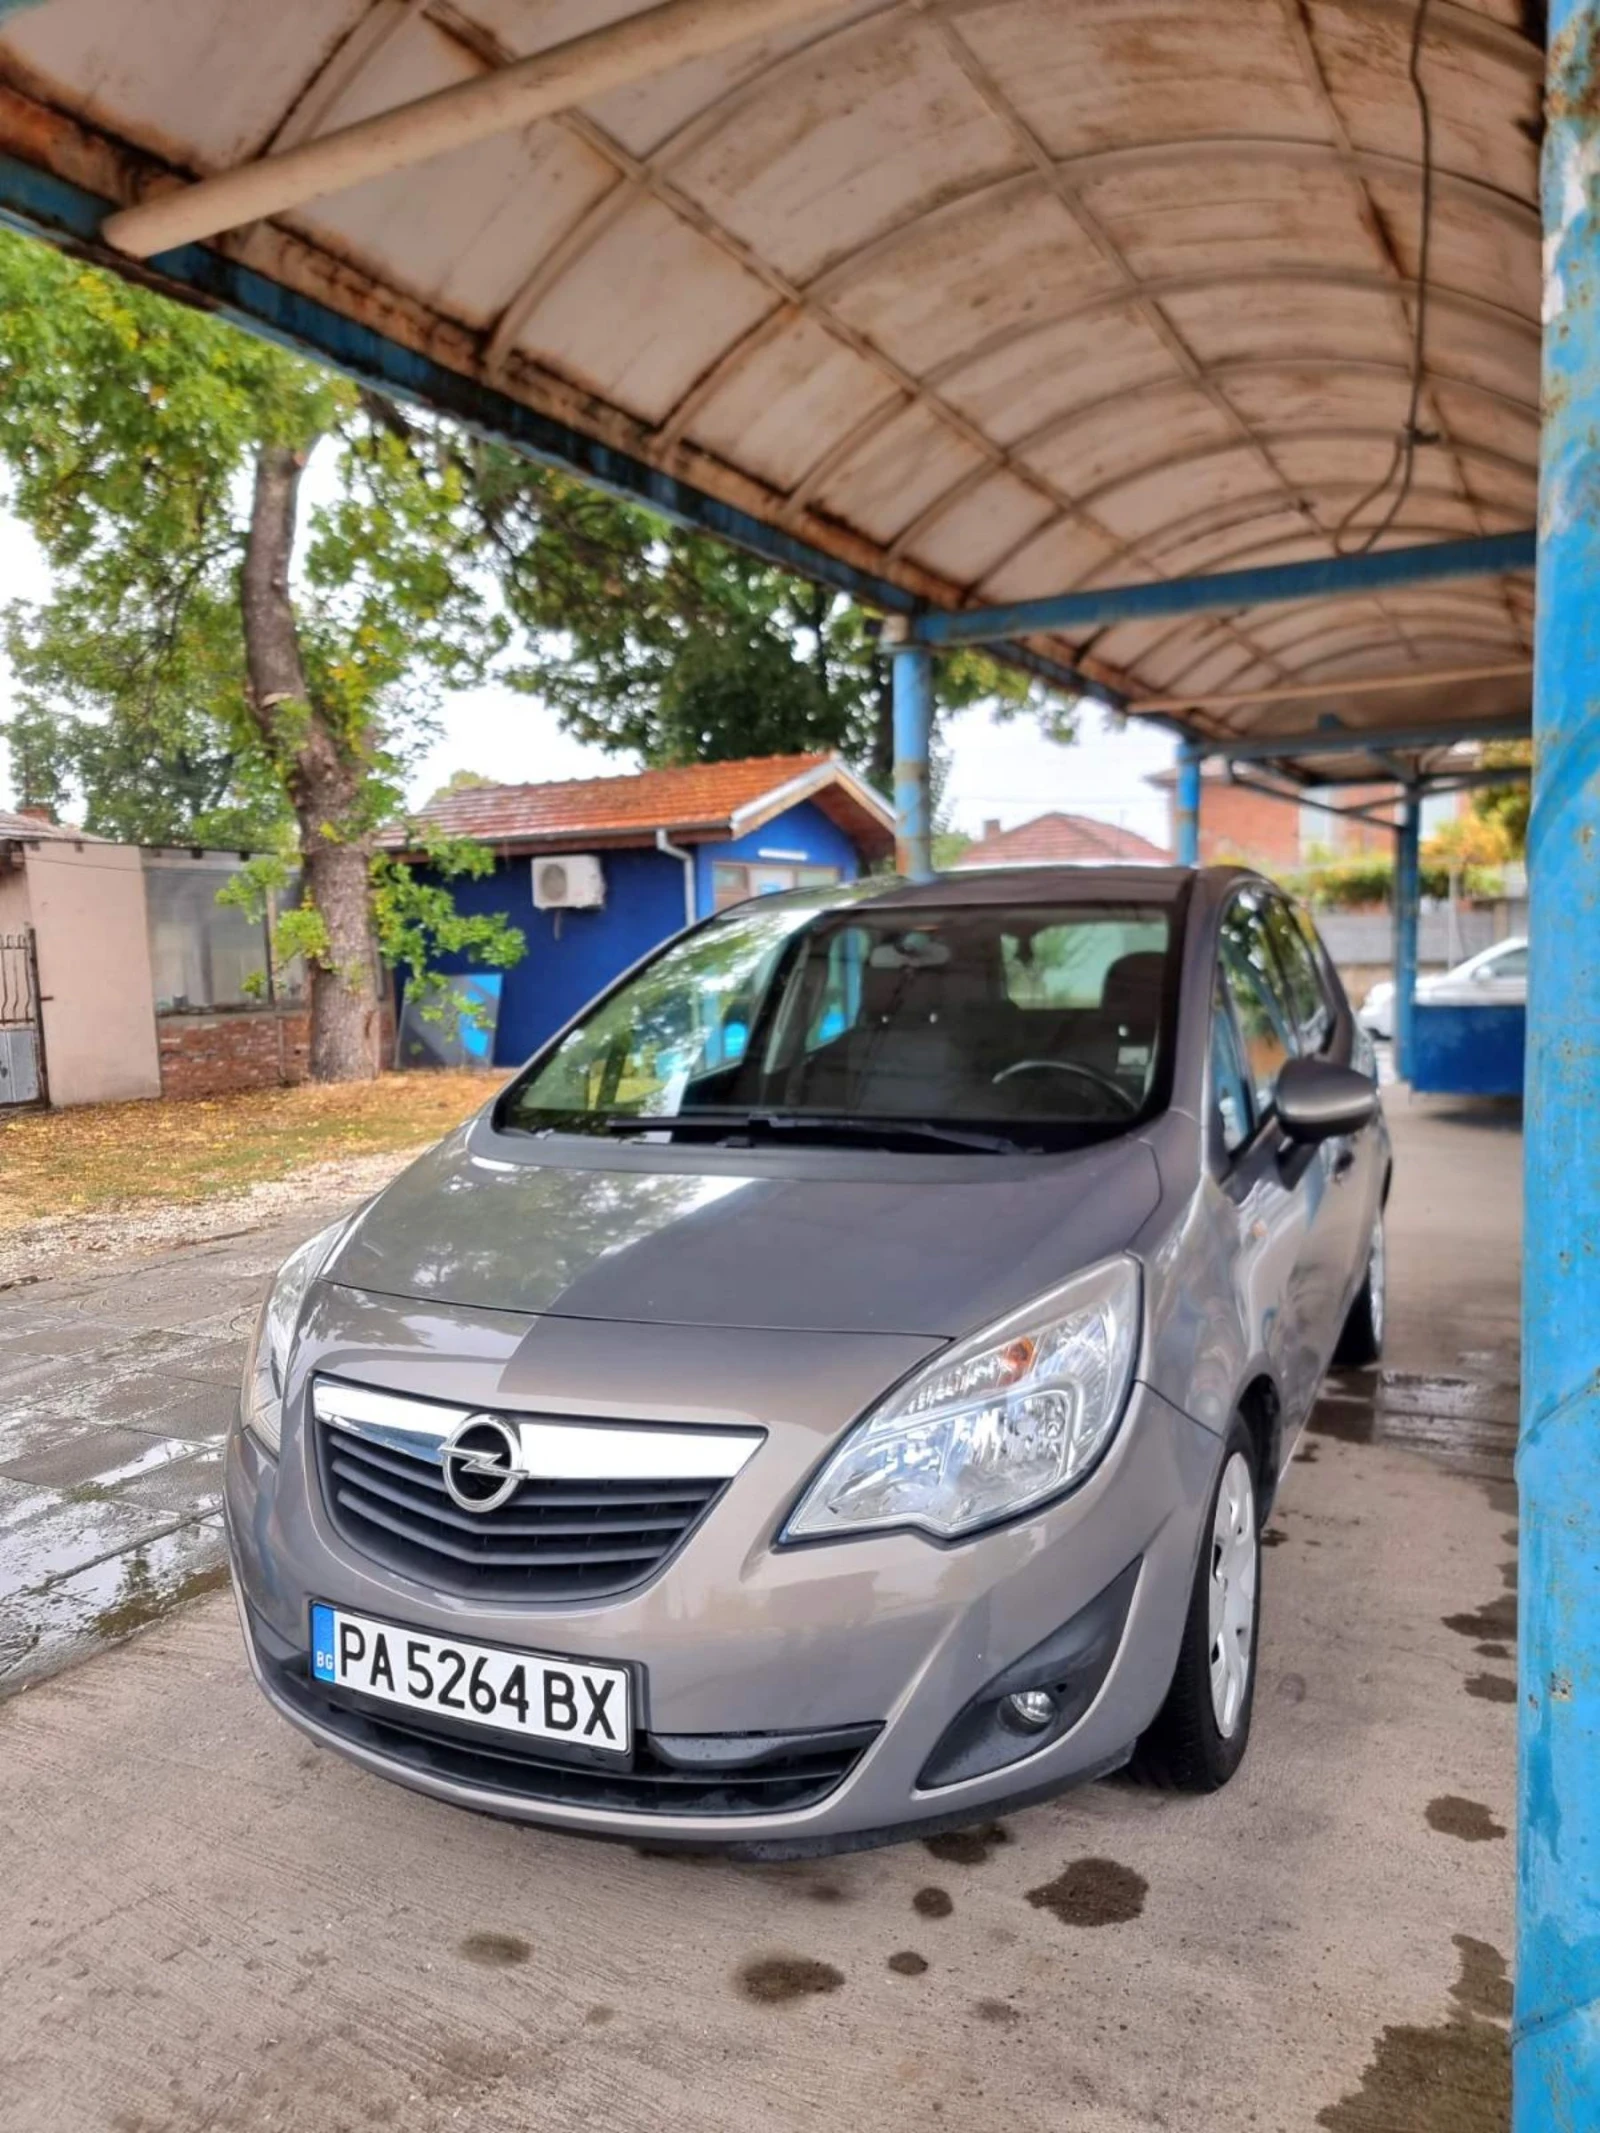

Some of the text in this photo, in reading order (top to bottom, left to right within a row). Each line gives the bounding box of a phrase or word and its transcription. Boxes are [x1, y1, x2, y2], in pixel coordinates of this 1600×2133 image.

[316, 1651, 334, 1671] BG
[340, 1622, 617, 1740] PA 5264 BX
